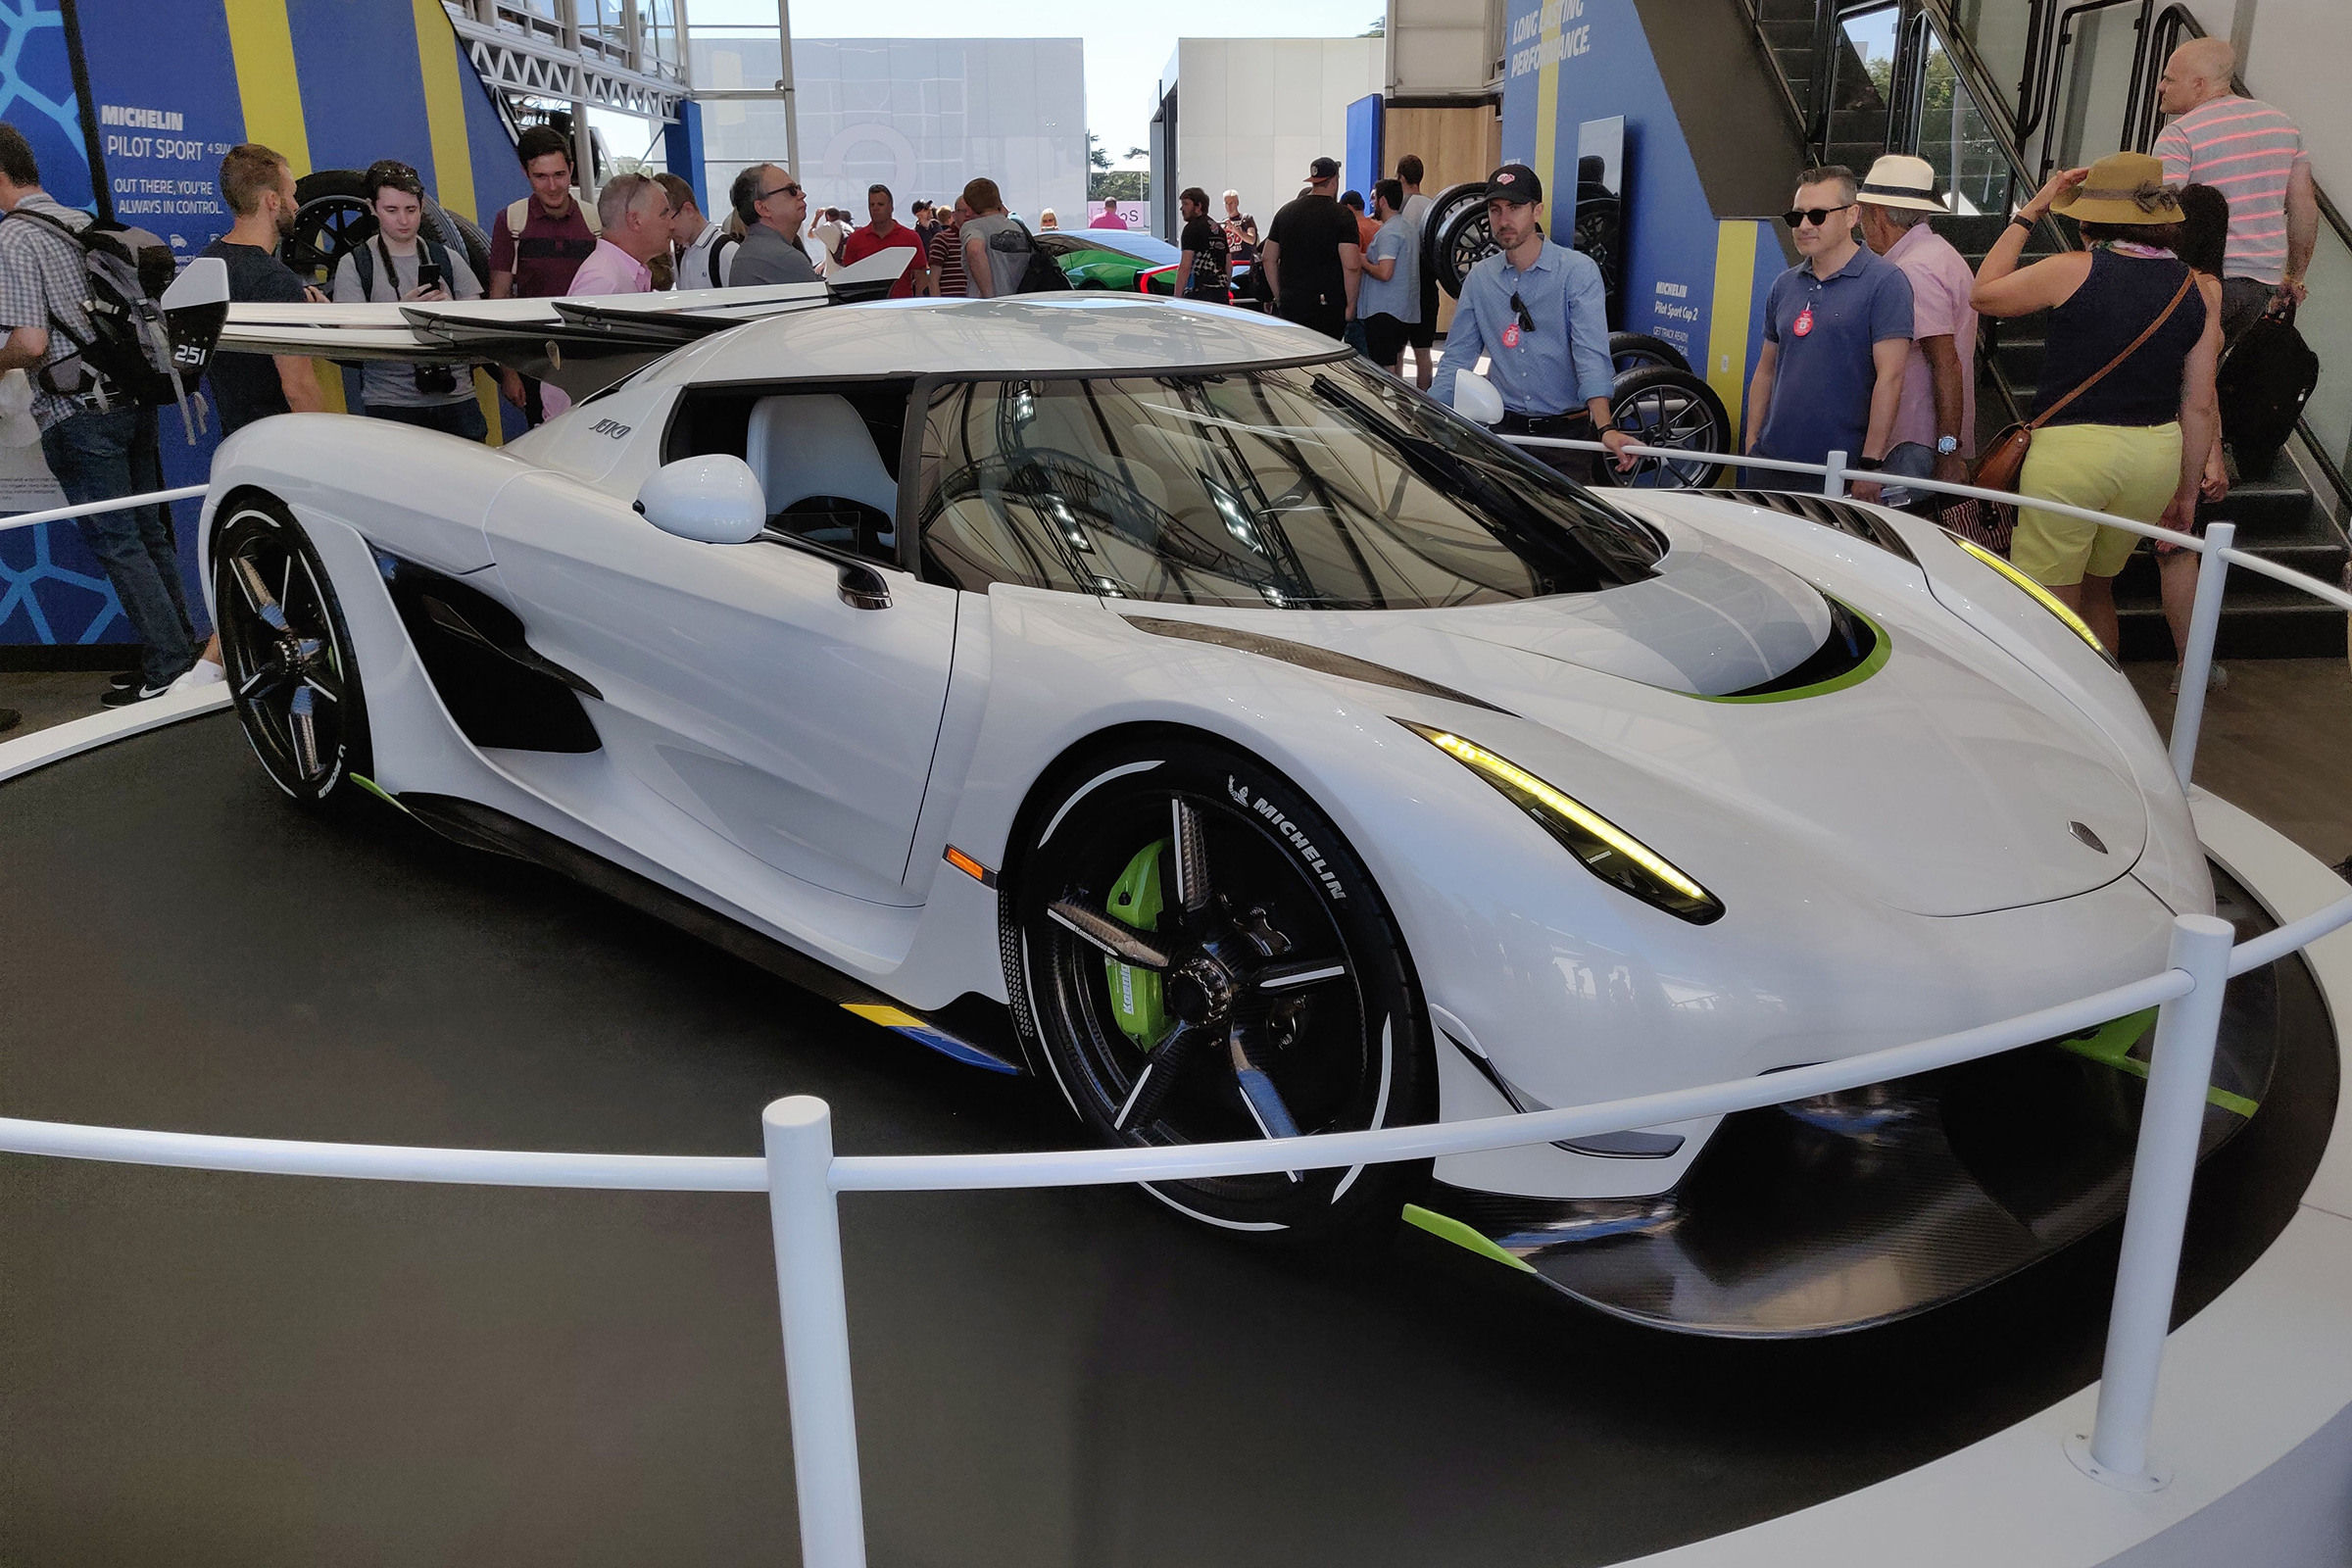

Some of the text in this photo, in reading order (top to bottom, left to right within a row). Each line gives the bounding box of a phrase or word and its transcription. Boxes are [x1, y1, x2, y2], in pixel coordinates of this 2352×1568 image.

[1512, 10, 1539, 45] LONG
[1511, 24, 1590, 78] PERFORMANCE.
[102, 105, 183, 131] MICHELIN
[108, 135, 153, 158] PILOT
[156, 138, 204, 161] SPORT
[207, 143, 214, 153] 4
[114, 178, 214, 195] OUT THERE, YOU'RE
[118, 199, 223, 215] ALWAYS IN CONTROL.
[1656, 281, 1688, 298] MICHELIN
[1654, 301, 1698, 323] Pilot Sport Cup 2
[174, 344, 207, 366] 251
[1252, 797, 1347, 900] MICHELIN
